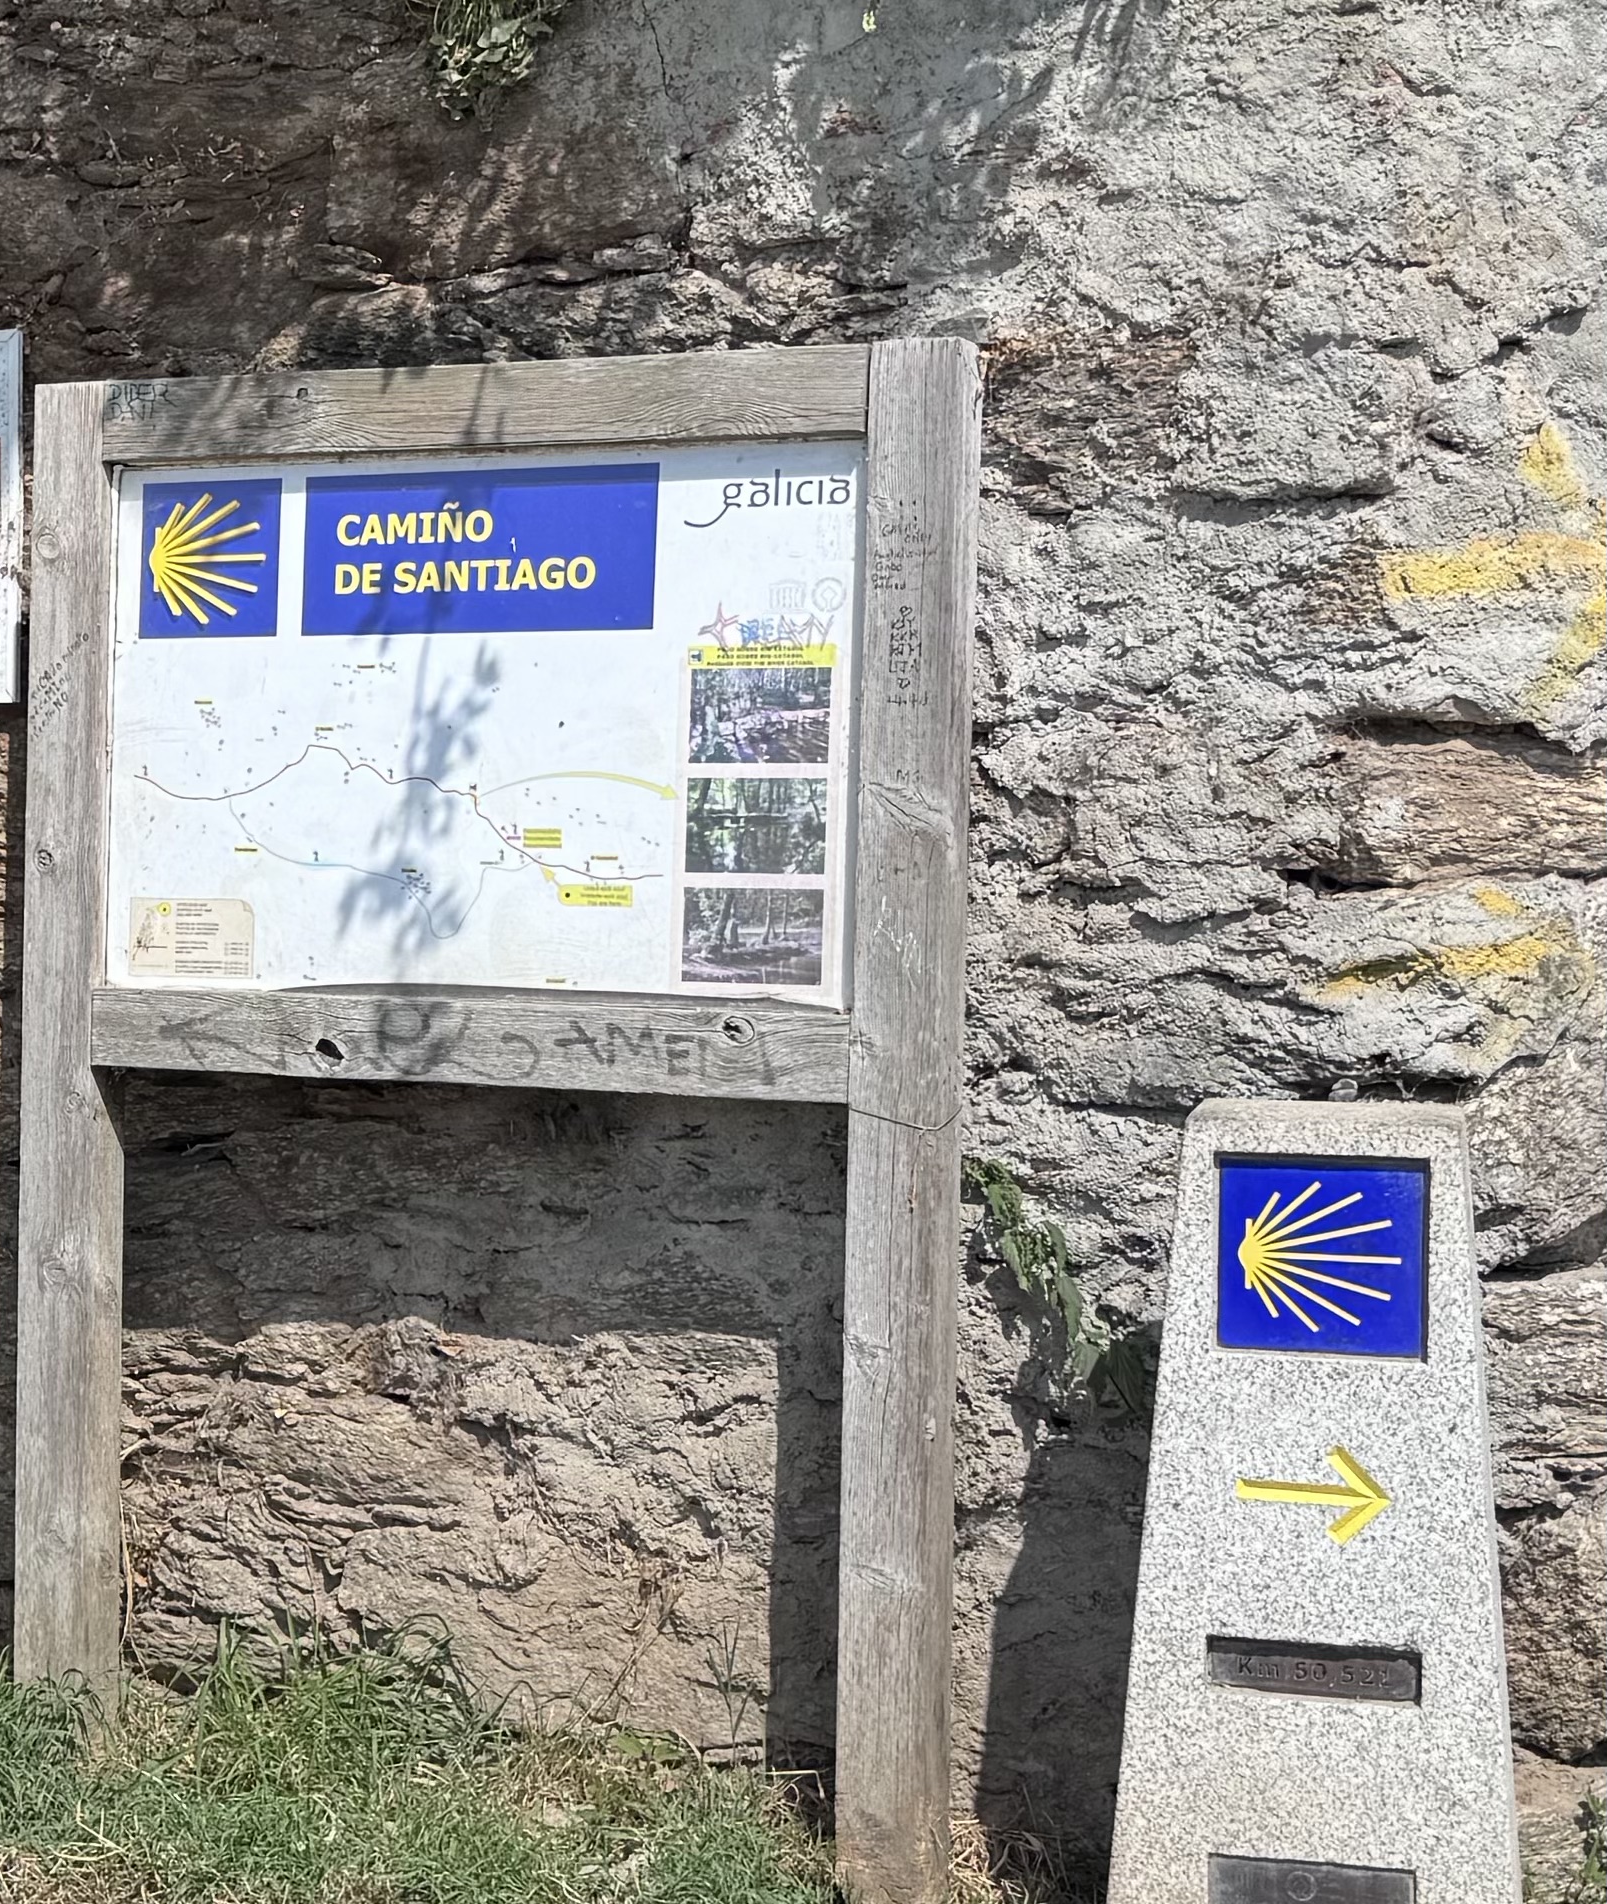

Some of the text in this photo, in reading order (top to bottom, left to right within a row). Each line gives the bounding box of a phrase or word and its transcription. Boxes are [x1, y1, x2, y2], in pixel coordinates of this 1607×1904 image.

[683, 468, 851, 528] galicia
[336, 500, 494, 547] CAMIÑO
[334, 556, 597, 595] DE SANTIAGO
[1237, 1655, 1280, 1679] Km
